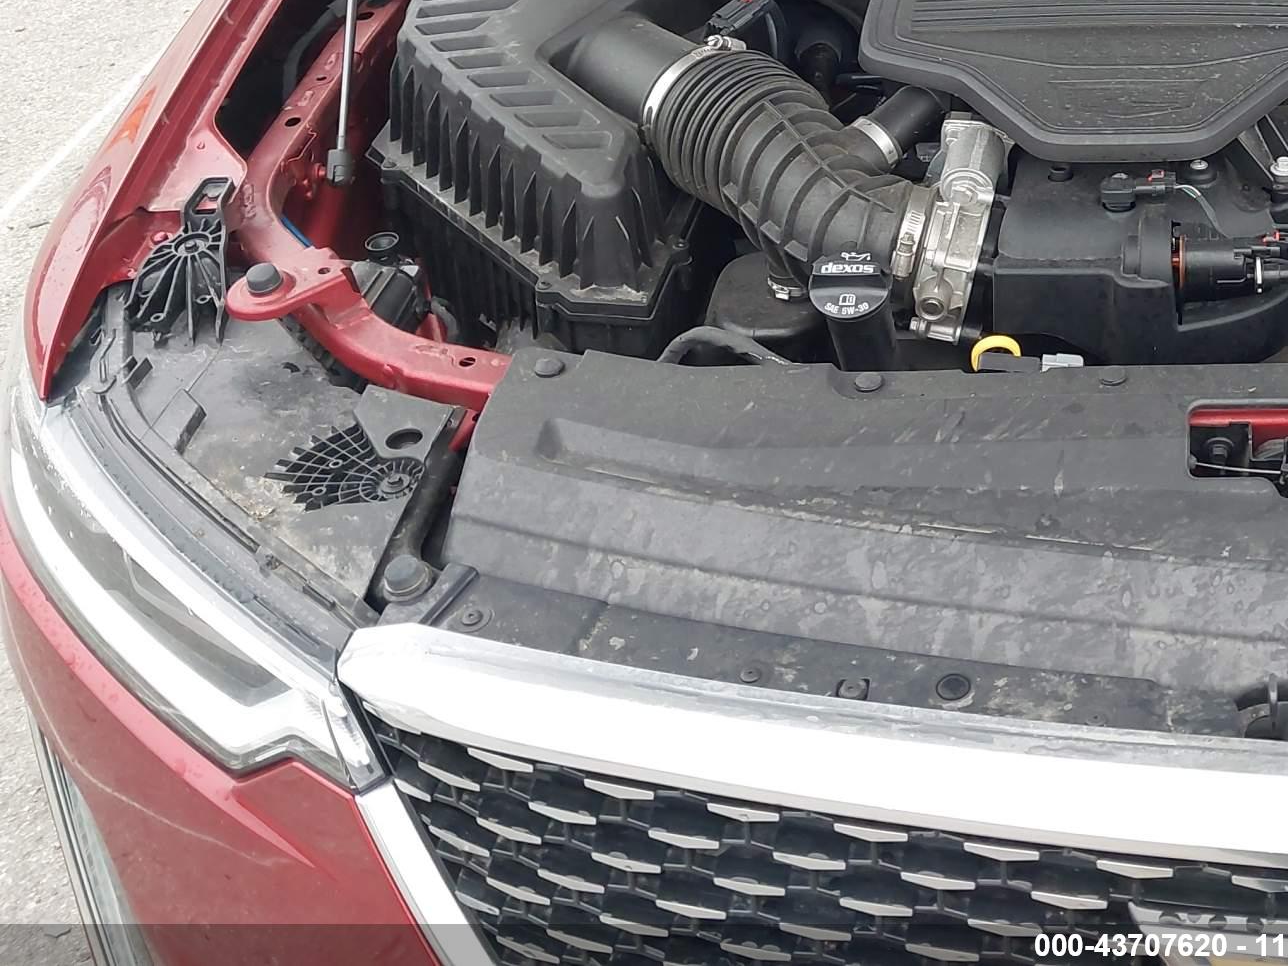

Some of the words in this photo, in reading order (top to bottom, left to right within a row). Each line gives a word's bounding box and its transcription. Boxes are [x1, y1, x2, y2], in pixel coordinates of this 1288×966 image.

[821, 262, 876, 273] dexos
[824, 302, 839, 314] SAE
[841, 302, 869, 314] 5W-30
